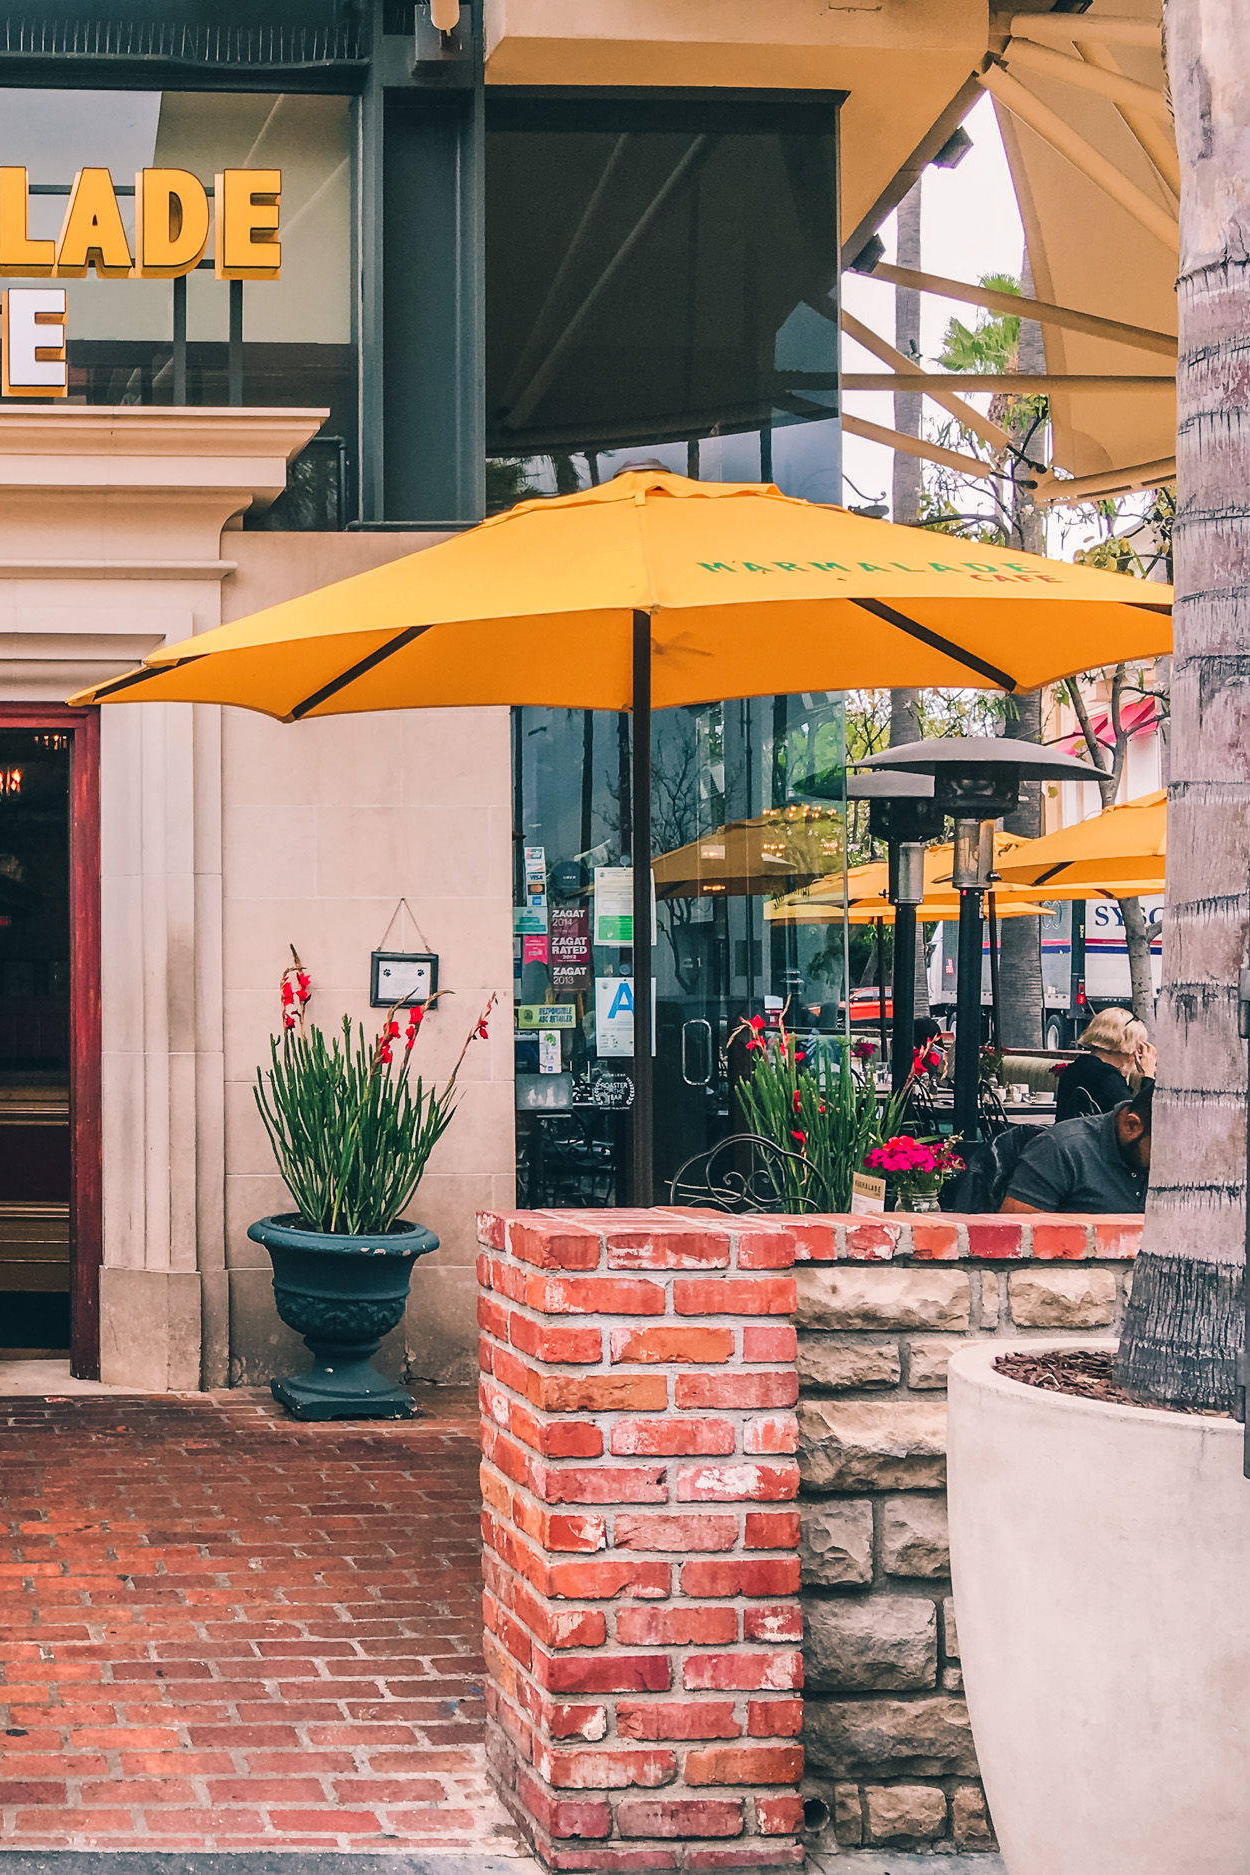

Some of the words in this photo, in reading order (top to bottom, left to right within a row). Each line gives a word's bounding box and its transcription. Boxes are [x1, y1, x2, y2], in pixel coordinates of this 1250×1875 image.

[695, 562, 1041, 573] MARMALADE
[970, 574, 1063, 583] CAFE
[552, 909, 585, 918] ZAGAT
[552, 918, 573, 927] 2014
[551, 937, 587, 946] ZAGAT
[551, 946, 588, 955] RATED
[553, 967, 587, 976] ZAGAT
[553, 976, 574, 985] 2013
[607, 982, 634, 1019] A
[539, 1007, 572, 1015] RESPONSIBLE
[550, 1015, 572, 1023] RETAILER
